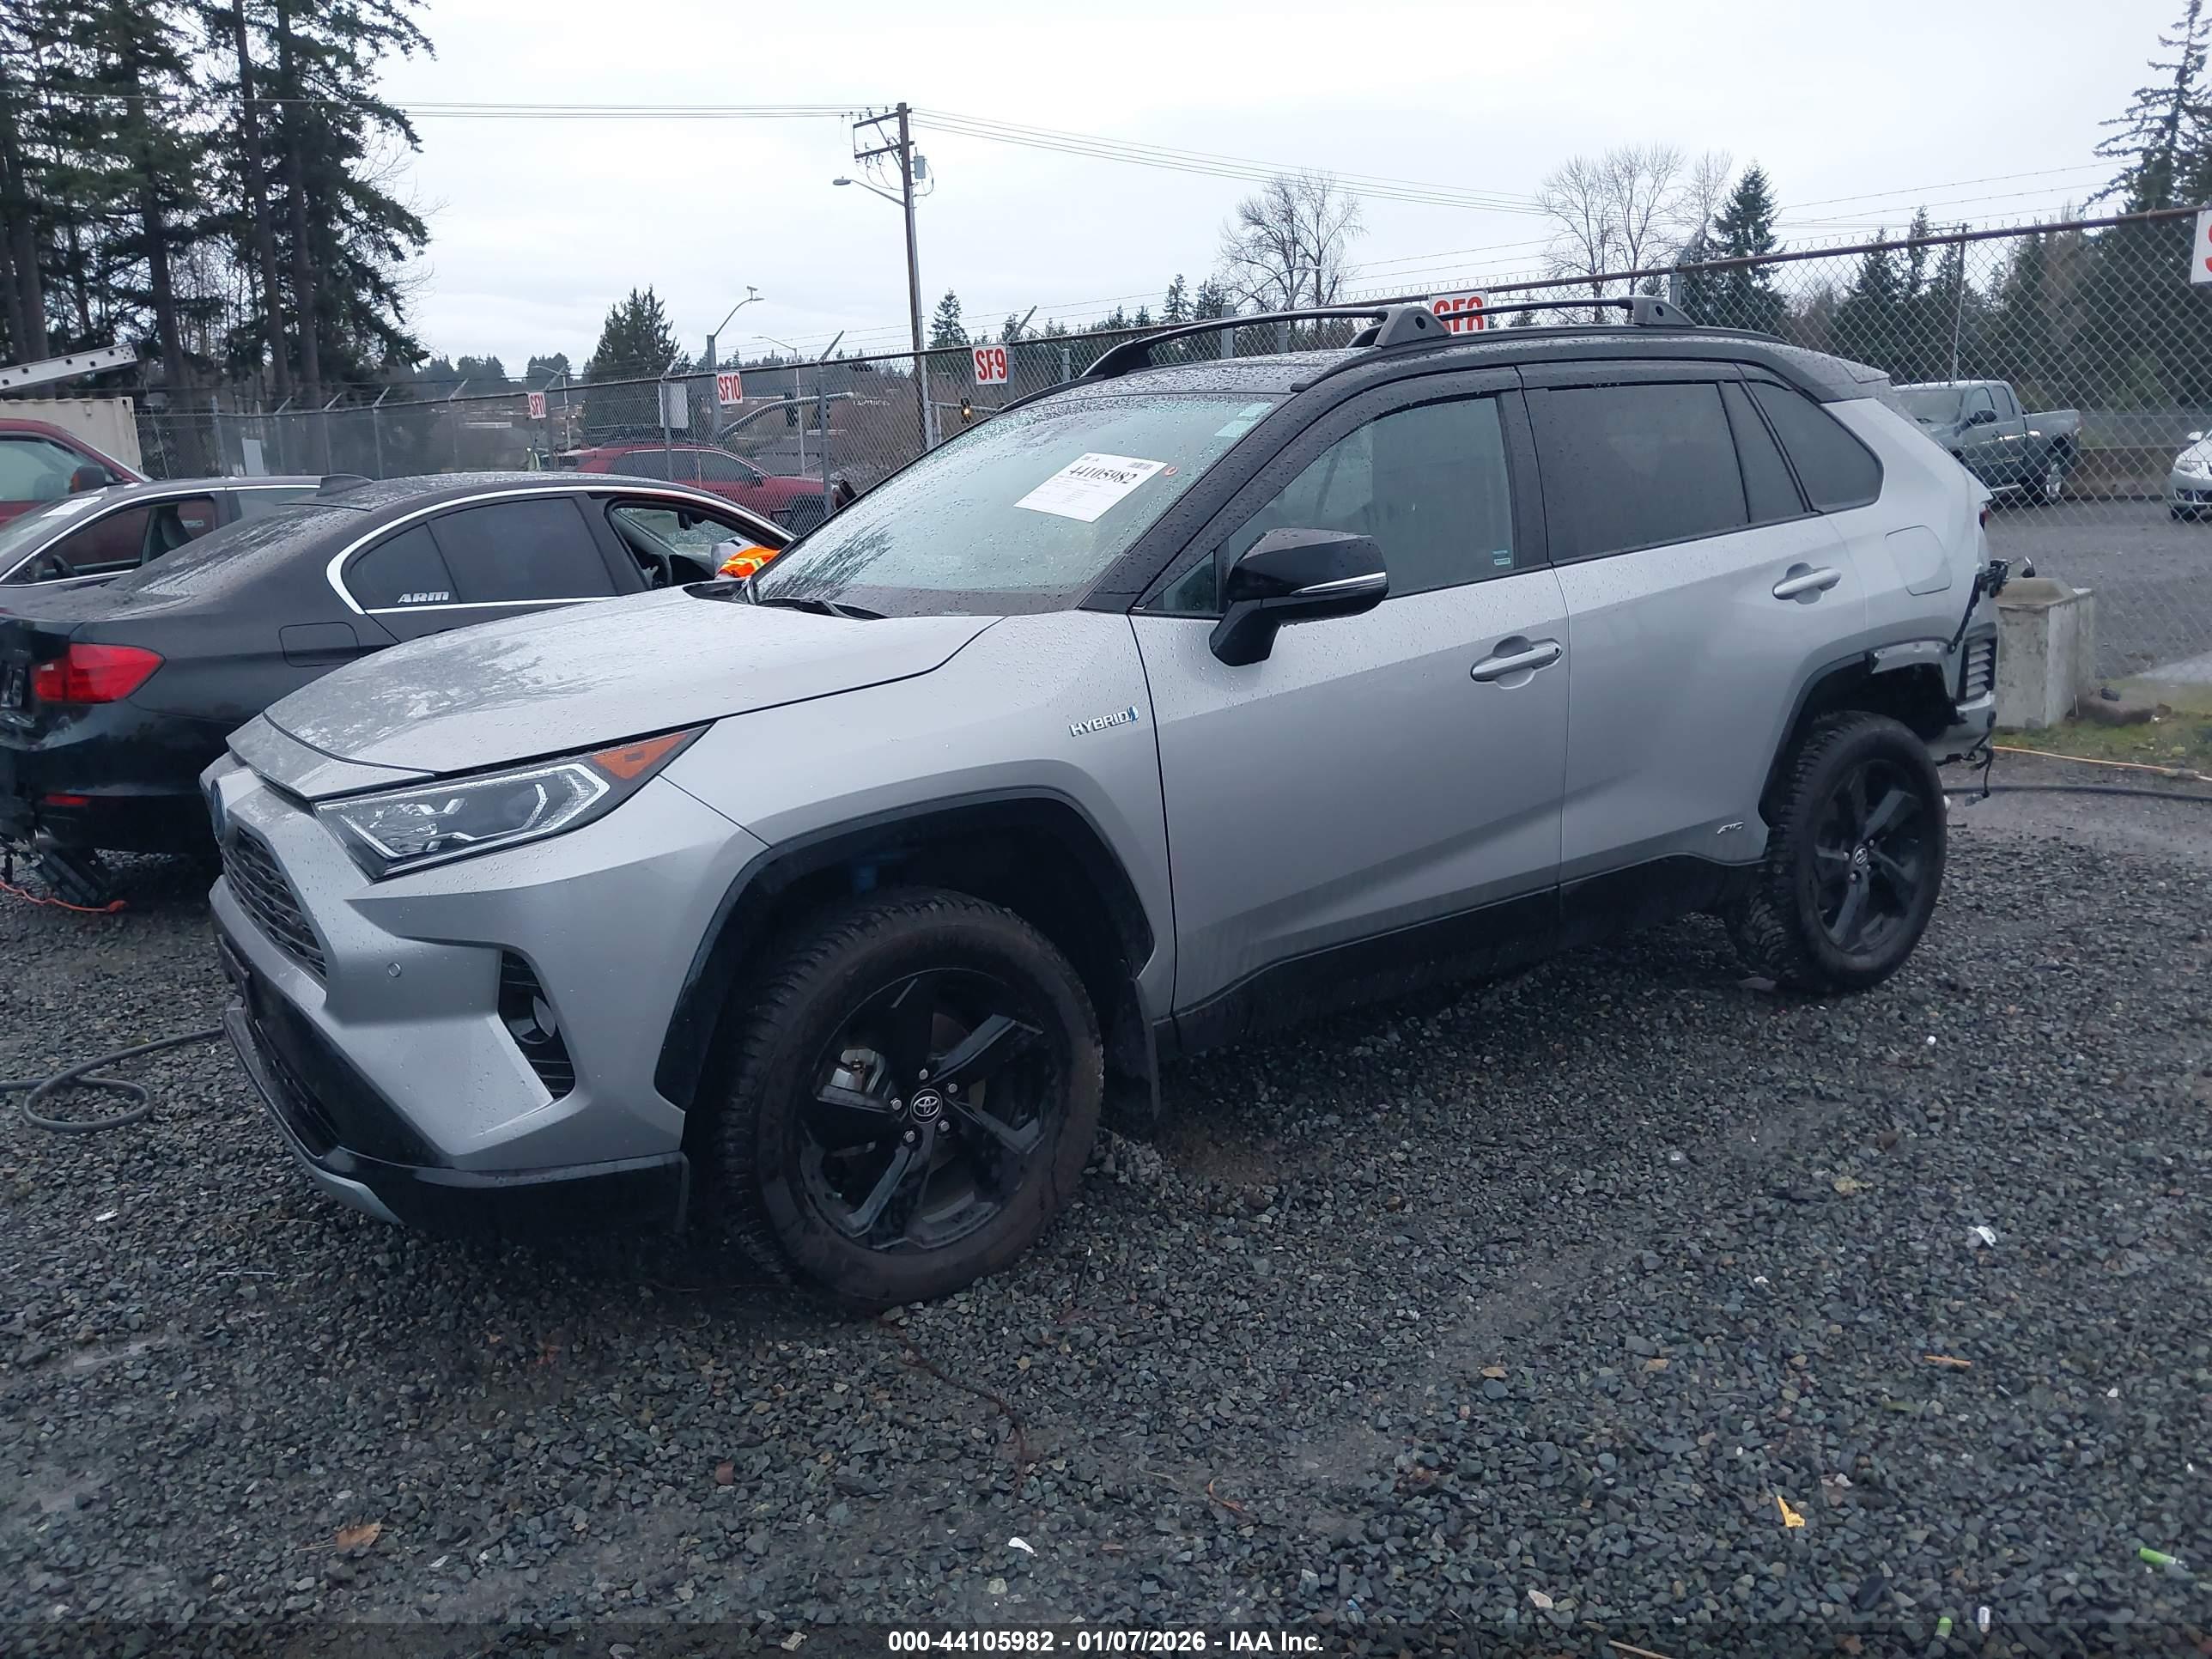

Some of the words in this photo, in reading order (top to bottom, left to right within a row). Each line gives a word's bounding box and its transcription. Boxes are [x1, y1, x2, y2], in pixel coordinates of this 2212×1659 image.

[975, 348, 1006, 380] SF9
[718, 374, 741, 401] SF10
[530, 395, 544, 415] SF11
[1069, 465, 1138, 483] 44105982
[1069, 711, 1131, 737] HYBRID
